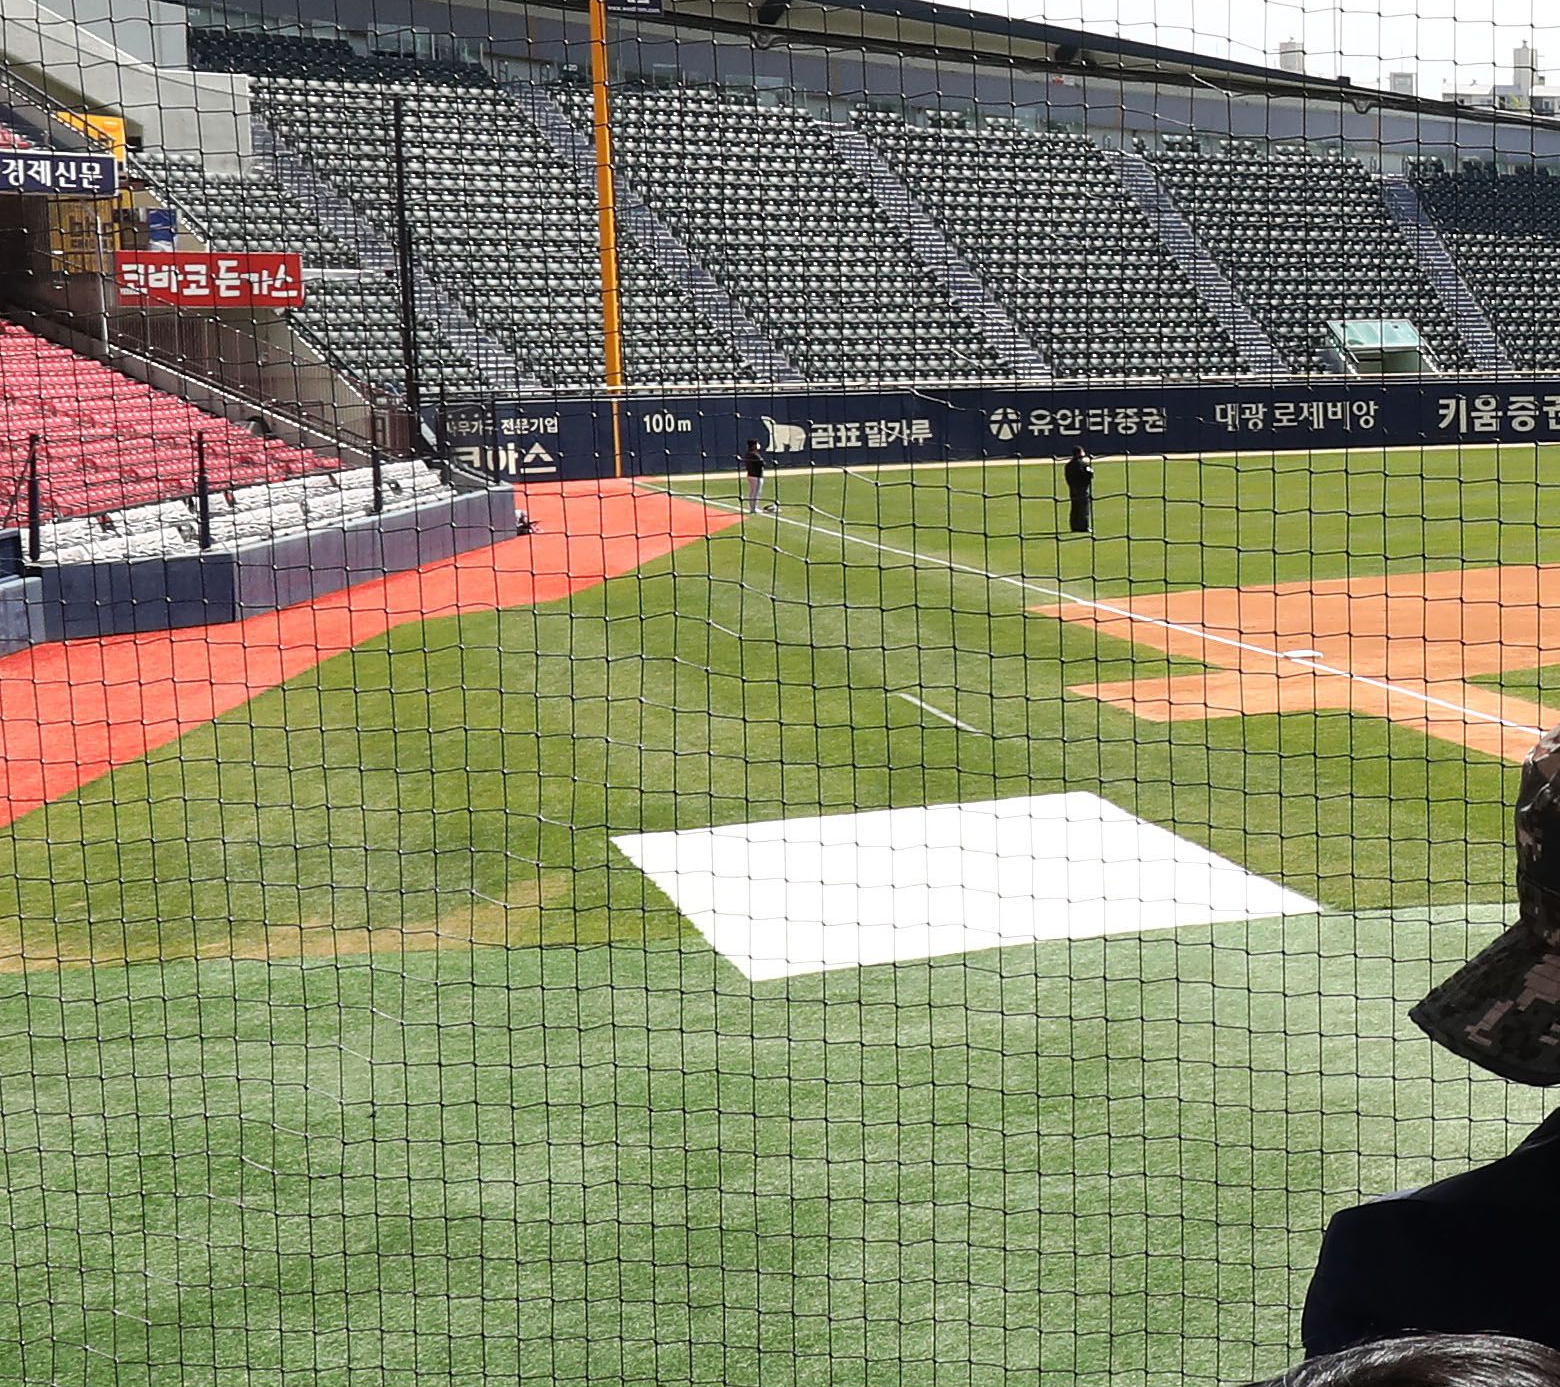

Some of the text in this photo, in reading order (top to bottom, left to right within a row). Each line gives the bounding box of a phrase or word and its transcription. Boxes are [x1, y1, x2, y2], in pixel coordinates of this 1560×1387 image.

[1, 157, 104, 189] 경제신문
[500, 416, 559, 435] 전문기업
[1027, 406, 1168, 436] 유안타증권
